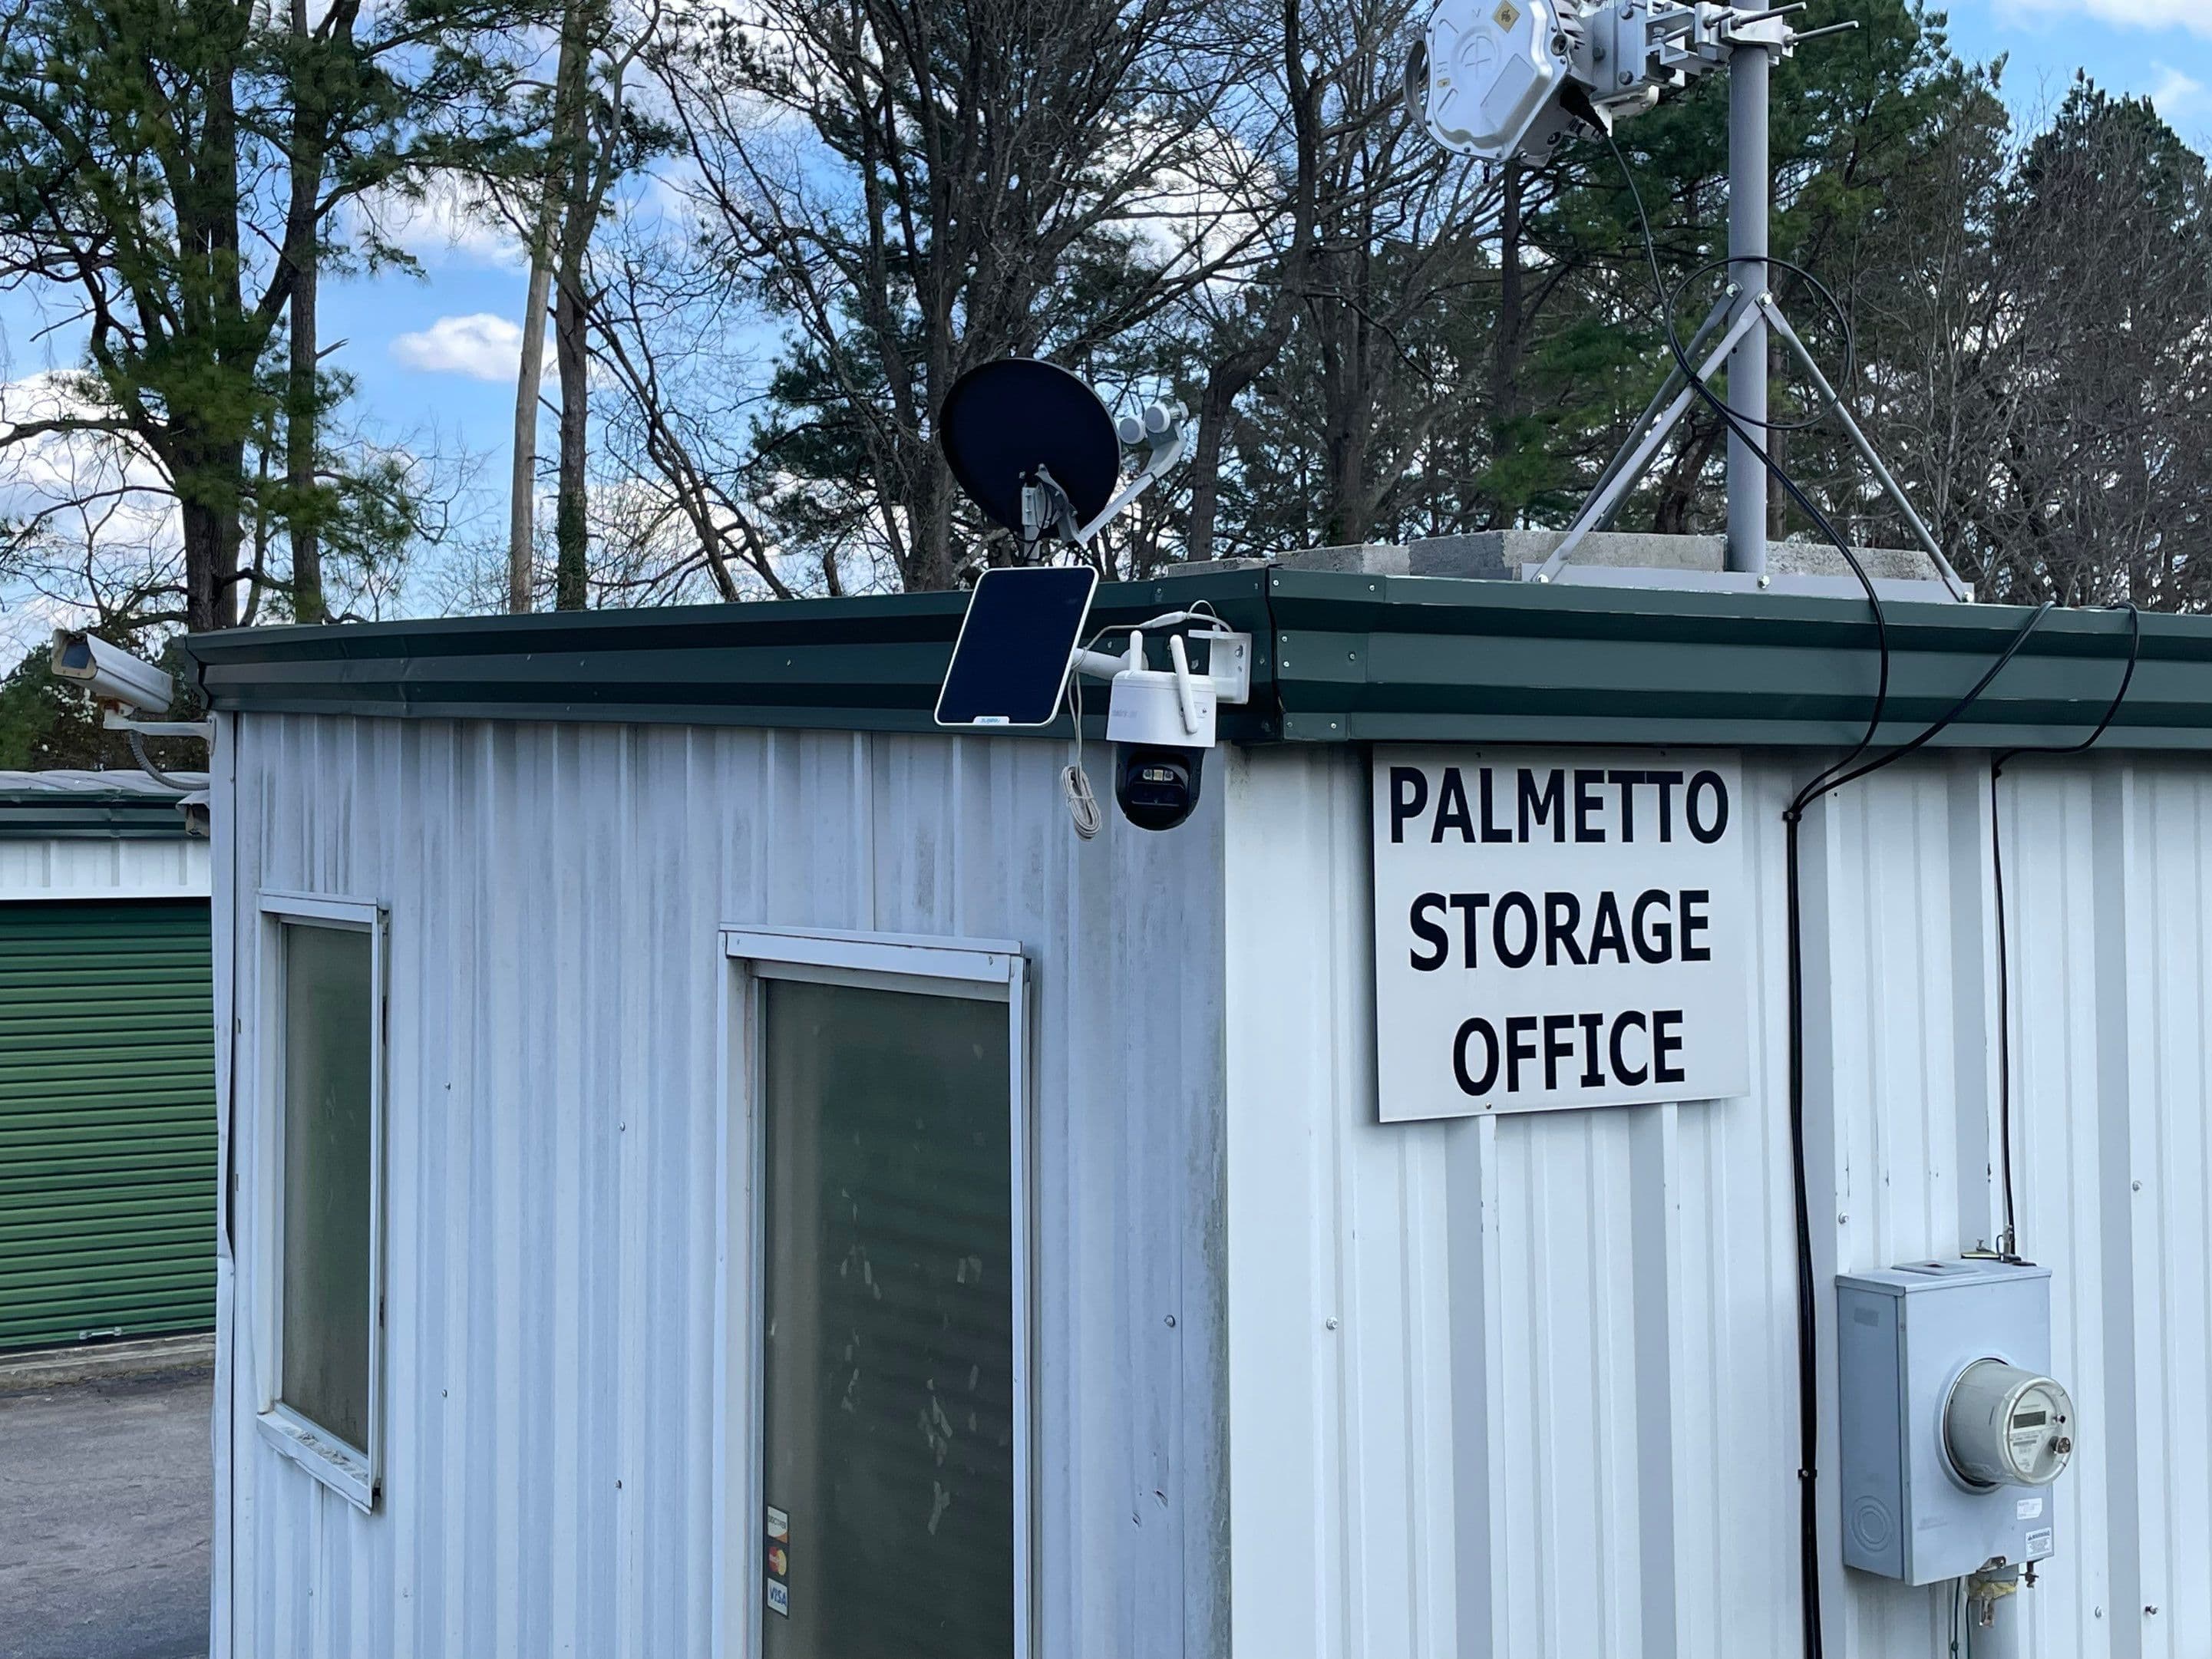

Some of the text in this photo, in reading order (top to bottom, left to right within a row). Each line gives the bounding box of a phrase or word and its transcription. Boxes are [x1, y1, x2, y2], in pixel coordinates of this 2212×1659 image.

[1389, 766, 1728, 844] PALMETTO
[1410, 889, 1711, 971] STORAGE
[1453, 1010, 1685, 1096] OFFICE
[770, 1585, 787, 1607] VISA
